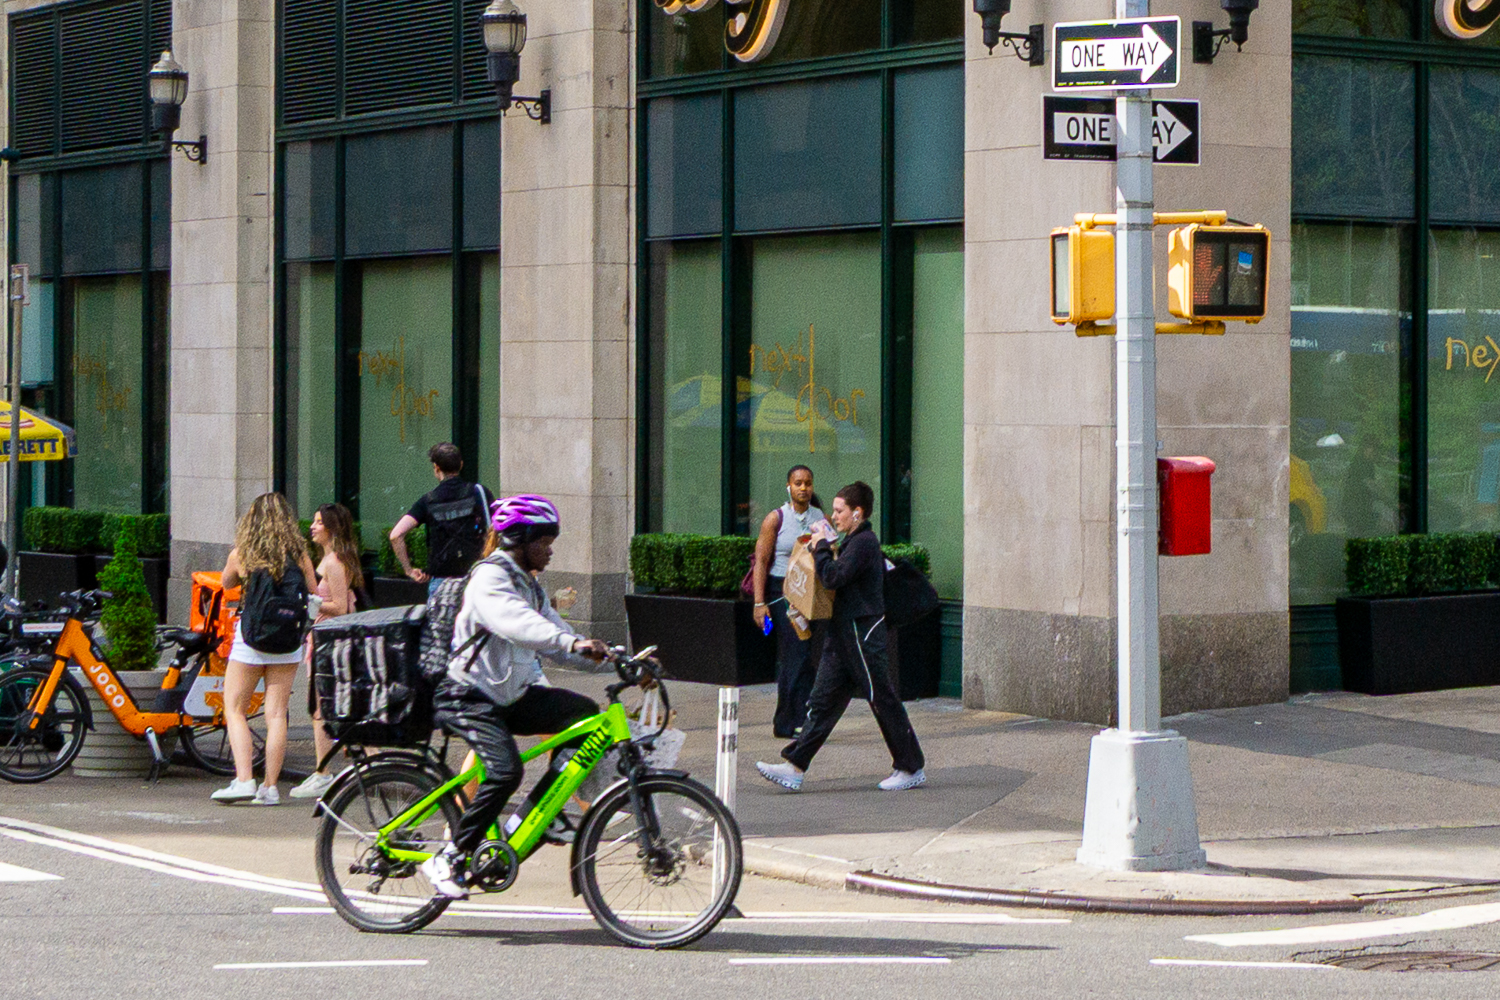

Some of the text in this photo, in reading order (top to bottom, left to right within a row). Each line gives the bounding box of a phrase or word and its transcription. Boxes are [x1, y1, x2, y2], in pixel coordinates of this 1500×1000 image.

[1071, 41, 1159, 68] ONE WAY
[1066, 116, 1177, 144] ONE AY
[749, 330, 807, 389] next
[795, 323, 865, 453] door
[89, 664, 125, 708] JOCO
[571, 726, 612, 770] WHIZZ
